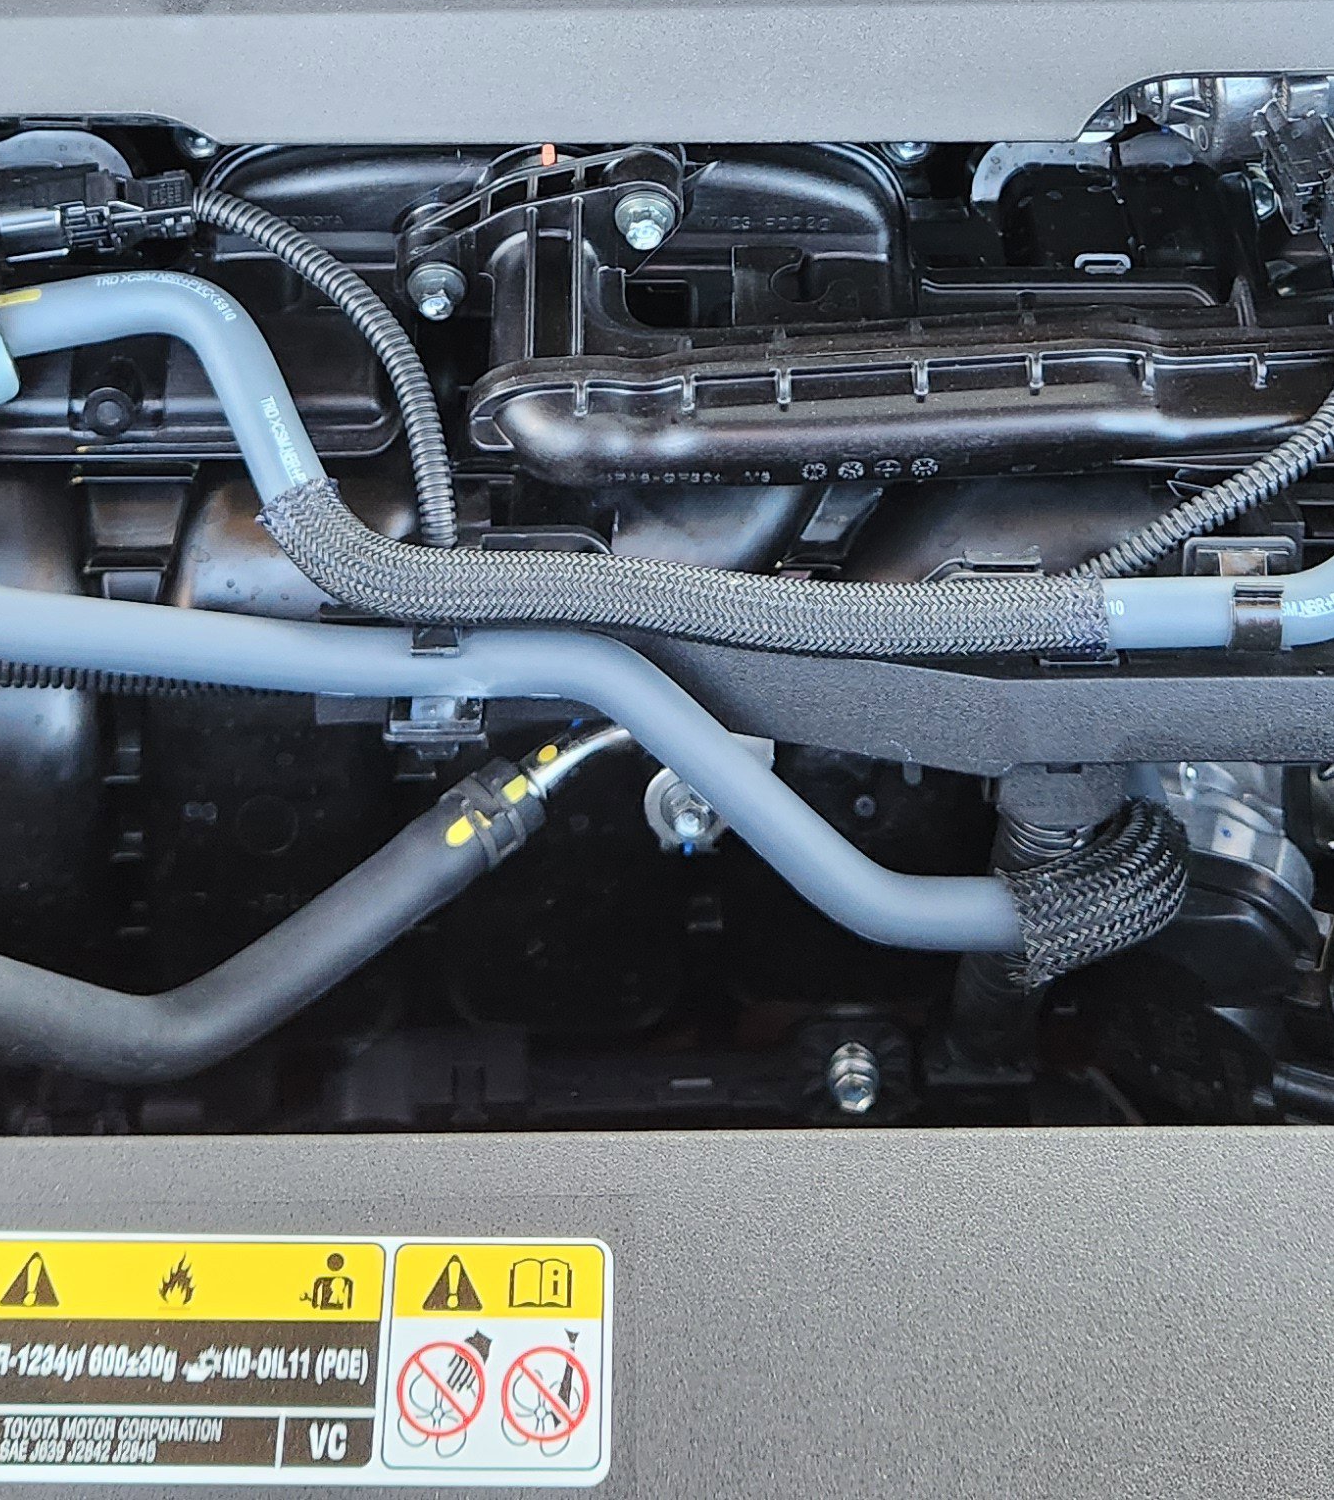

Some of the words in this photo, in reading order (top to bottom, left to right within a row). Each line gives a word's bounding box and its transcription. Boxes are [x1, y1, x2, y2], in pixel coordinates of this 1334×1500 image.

[95, 275, 118, 287] TRD
[260, 395, 280, 421] TRD
[315, 1346, 369, 1385] (POE)
[2, 1417, 62, 1440] TOYOTA
[61, 1418, 116, 1441] MOTOR
[117, 1418, 223, 1443] CORPORATION
[309, 1422, 348, 1461] VC
[29, 1439, 67, 1463] J639
[66, 1439, 112, 1463] J2842
